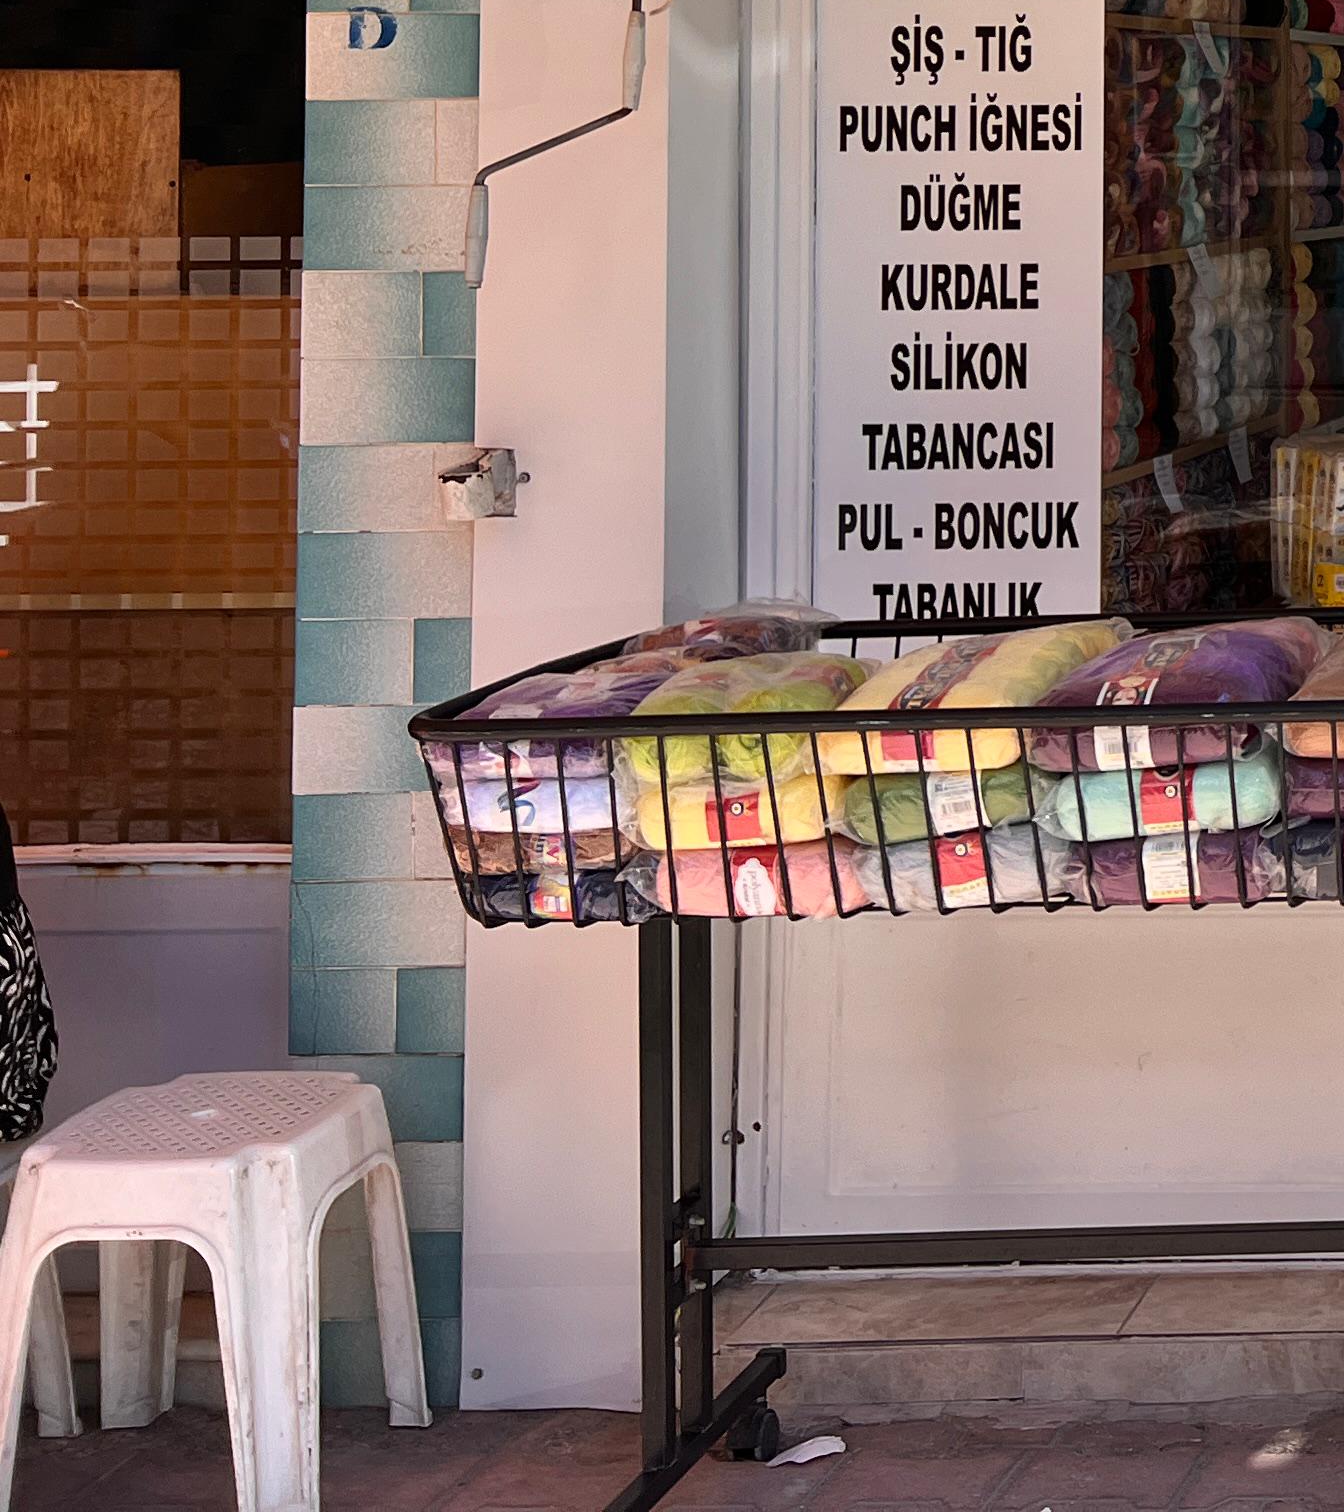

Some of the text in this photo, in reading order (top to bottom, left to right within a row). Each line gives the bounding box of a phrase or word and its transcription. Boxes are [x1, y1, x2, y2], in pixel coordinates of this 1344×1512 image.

[890, 14, 944, 85] ŞİŞ
[975, 14, 1032, 73] TIĞ
[839, 92, 1083, 152] PUNCH İĞNESİ
[900, 173, 1021, 231] DÜĞME
[881, 263, 1039, 311] KURDALE
[890, 331, 1027, 391] SİLİKON
[862, 422, 1054, 470] TABANCASI
[838, 502, 902, 551] PUL
[934, 501, 1079, 550] BONCUK
